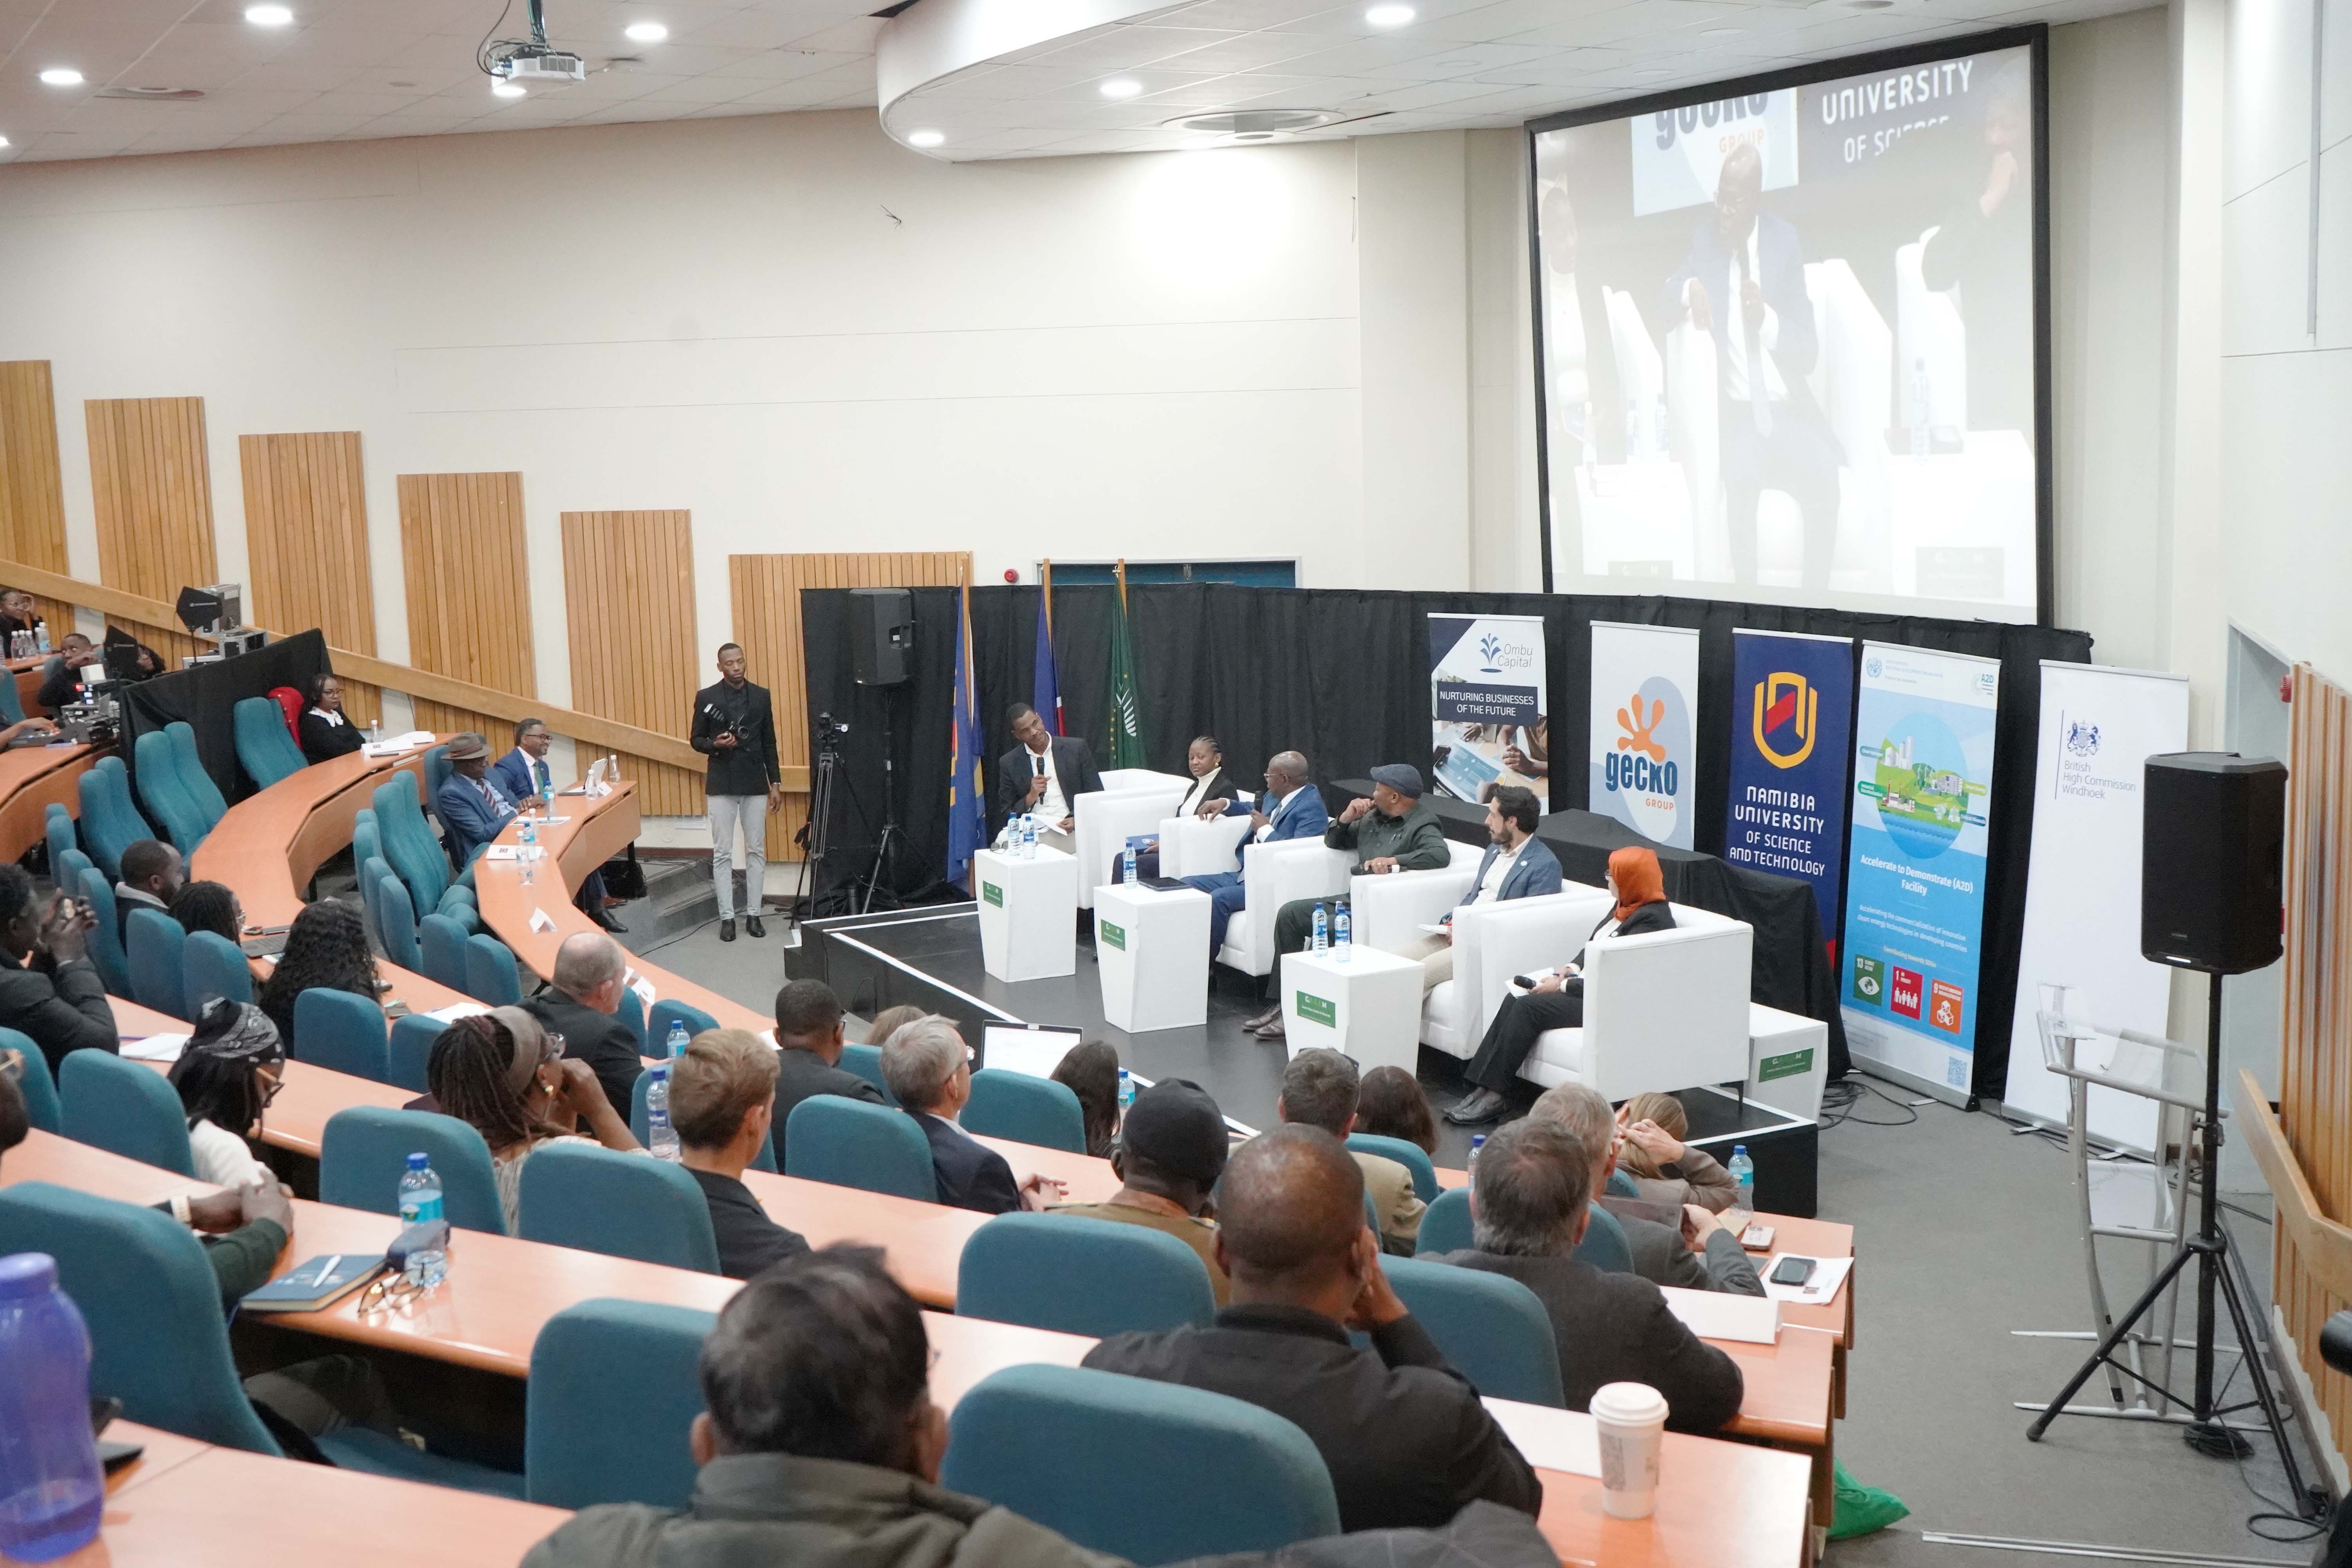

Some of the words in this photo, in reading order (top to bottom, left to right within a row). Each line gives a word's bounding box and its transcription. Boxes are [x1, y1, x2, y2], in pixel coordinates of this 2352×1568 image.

[1822, 59, 1973, 125] UNIVERSITY
[1844, 134, 1866, 163] OF
[1504, 644, 1533, 655] Ombu
[1497, 655, 1532, 669] Capital
[1981, 674, 1994, 683] A2D
[1440, 691, 1484, 702] NURTURING
[1486, 693, 1534, 705] BUSINESSES
[1457, 704, 1468, 713] OF
[1469, 705, 1484, 714] THE
[1486, 706, 1516, 716] FUTURE
[2064, 760, 2091, 772] British
[1606, 752, 1677, 796] gecko
[2063, 772, 2082, 784] High
[2085, 775, 2136, 791] Commission
[1747, 786, 1815, 811] NAMIBIA
[2062, 784, 2105, 799] Windhoek
[1646, 798, 1674, 810] GROUP
[1735, 804, 1824, 834] UNIVERSITY
[1746, 831, 1760, 844] OF
[1764, 834, 1811, 854] SCIENCE
[1730, 847, 1751, 862] AND
[1753, 851, 1825, 876] TECHNOLOGY
[1861, 855, 1896, 871] Accelerate
[1898, 864, 1905, 874] to
[1906, 866, 1951, 887] Demonstrate
[1953, 878, 1974, 894] (A2D)
[1902, 879, 1927, 896] Facility
[1857, 957, 1864, 968] 13
[1896, 970, 1899, 980] 1
[1934, 983, 1938, 994] 9
